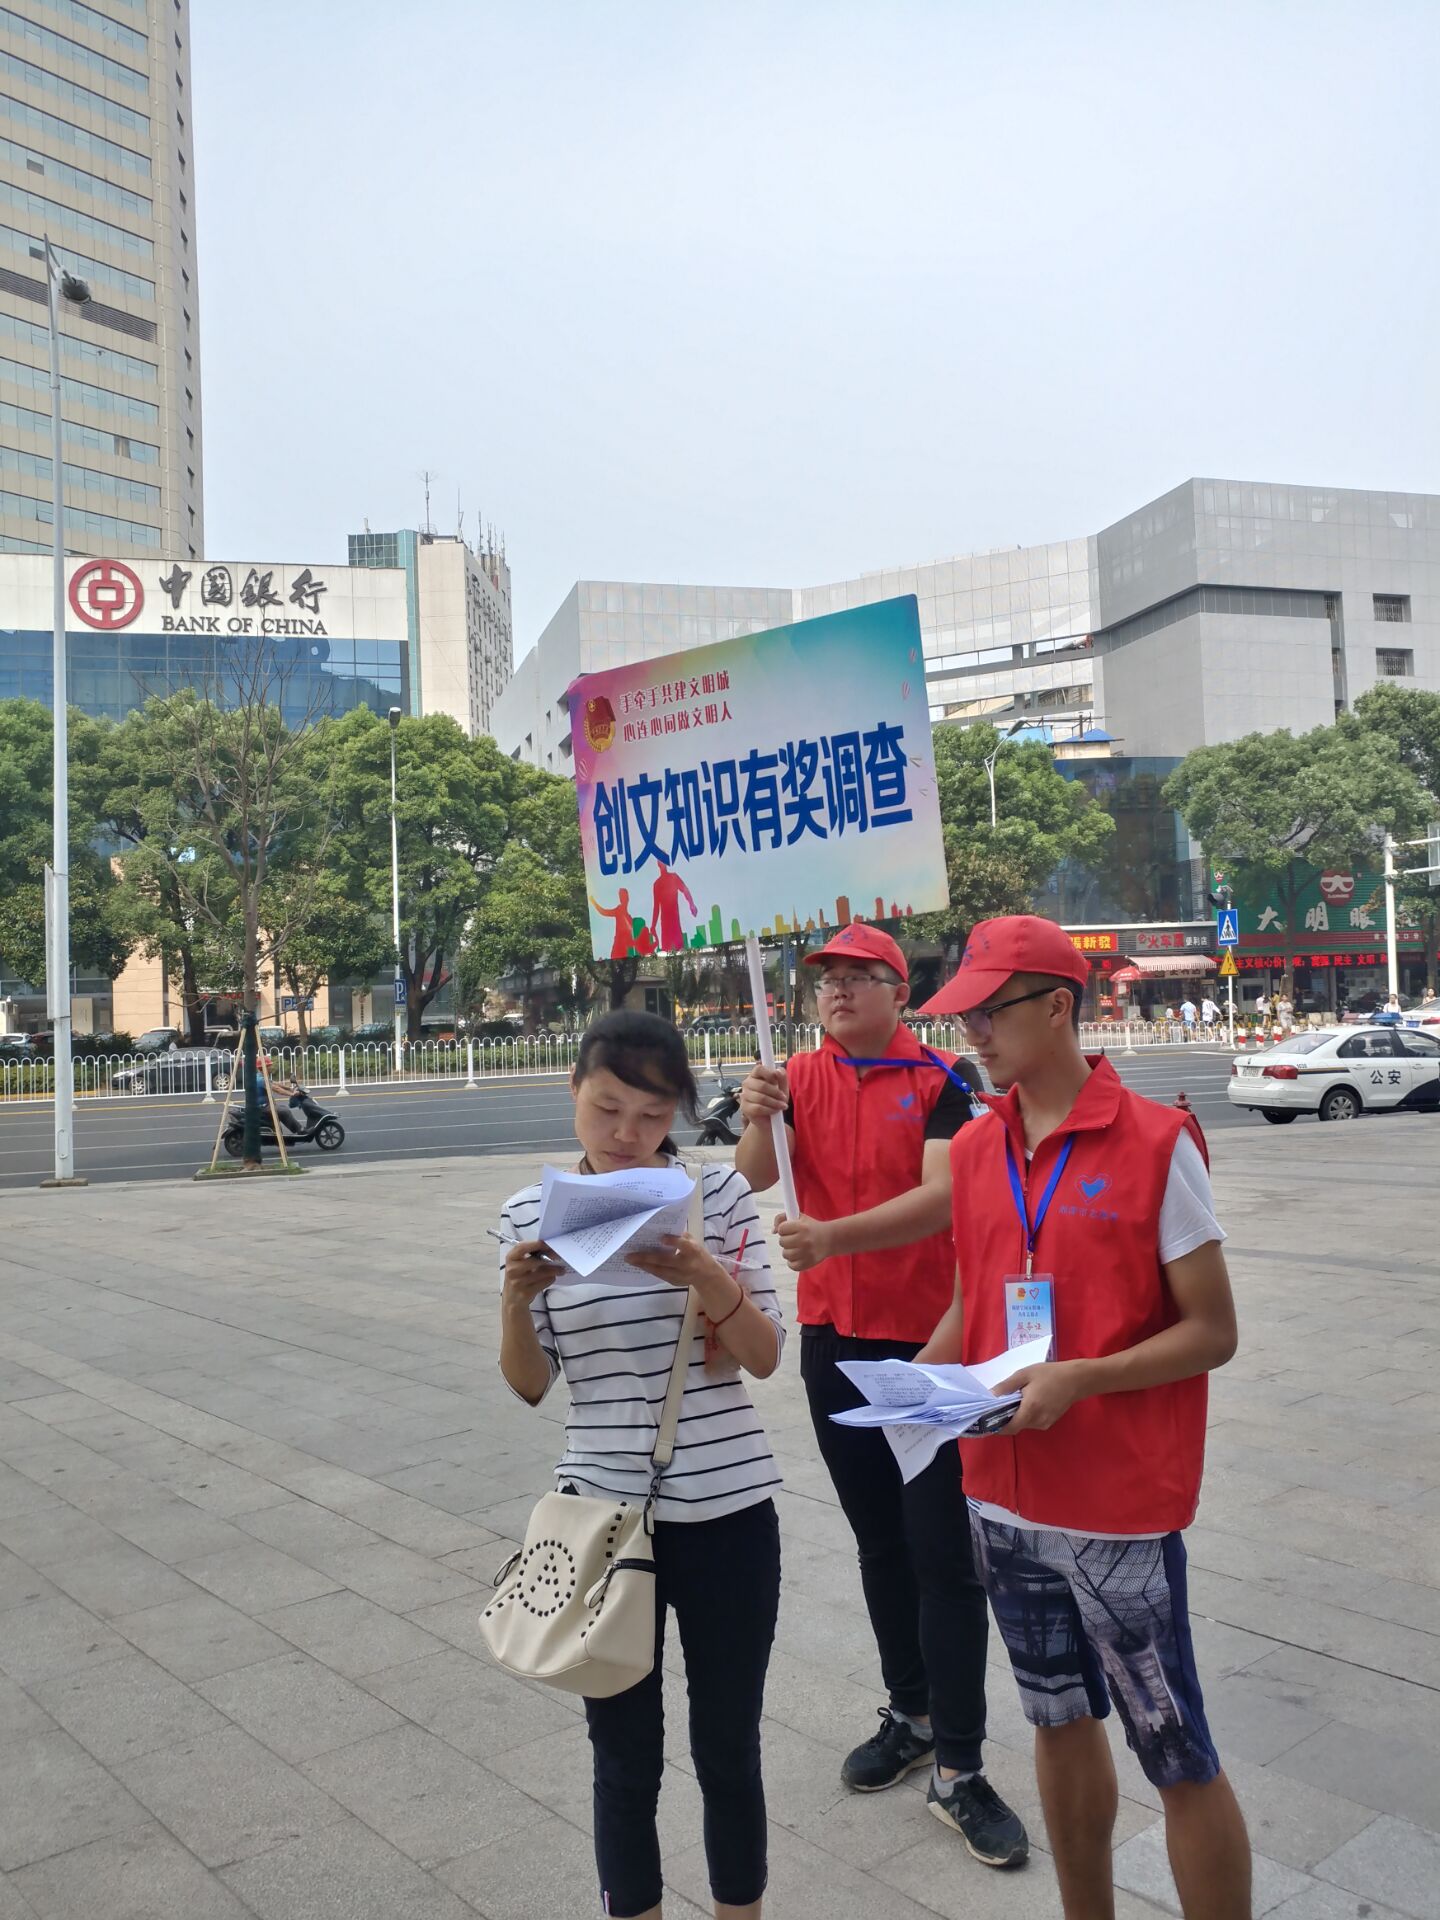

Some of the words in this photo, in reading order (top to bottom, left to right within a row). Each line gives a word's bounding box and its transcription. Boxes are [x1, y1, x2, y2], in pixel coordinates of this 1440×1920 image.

[162, 615, 221, 633] BANK
[228, 617, 253, 634] OF
[262, 617, 329, 636] CHINA
[619, 670, 731, 714] 手牵手共建文明城
[623, 700, 733, 743] 心连心同做文明人
[592, 721, 914, 877] 创文知识有奖调查
[1369, 1068, 1402, 1086] 公安
